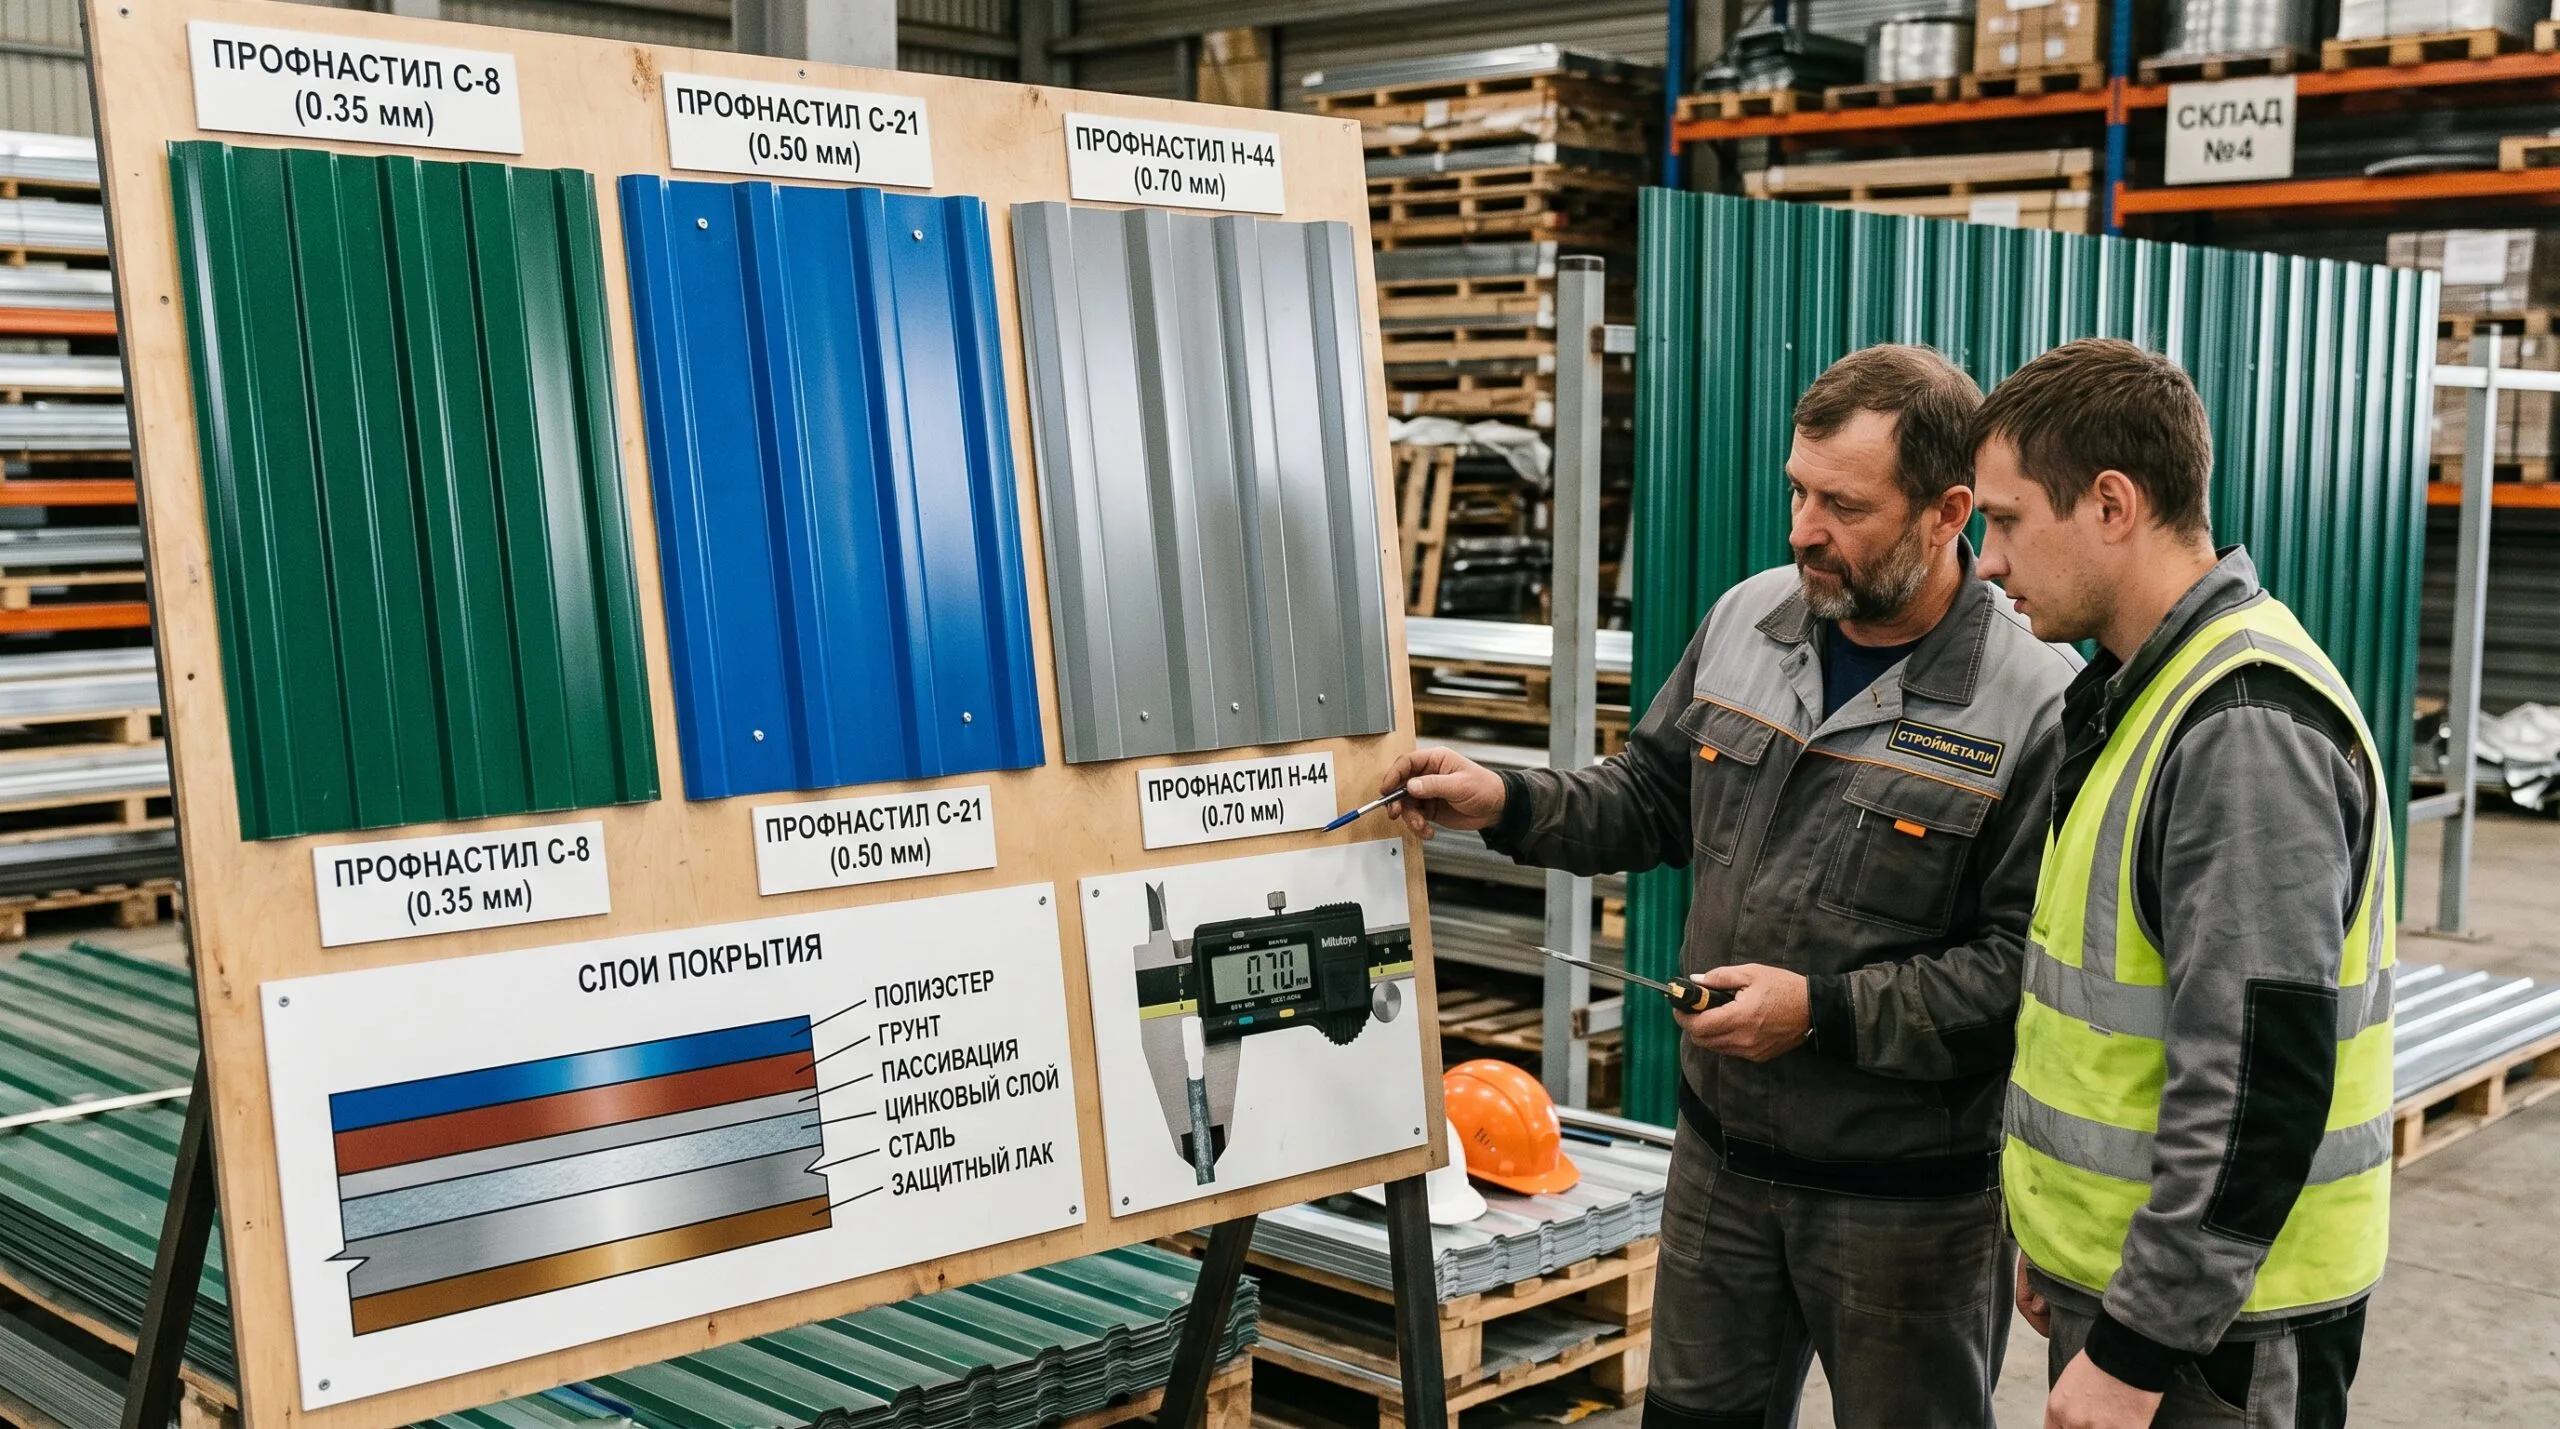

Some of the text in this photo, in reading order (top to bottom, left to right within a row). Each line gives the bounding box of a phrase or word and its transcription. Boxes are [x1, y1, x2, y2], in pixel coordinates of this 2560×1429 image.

[212, 38, 501, 95] ПРОФНАСТИЛ С-8
[295, 89, 434, 137] (0.35 мм)
[676, 87, 918, 136] ПРОФНАСТИЛ С-21
[2176, 97, 2284, 130] СКЛАД
[749, 132, 861, 174] (0.50 мм)
[1076, 126, 1275, 167] ПРОФНАСТИЛ Н-44
[2202, 137, 2255, 165] №4
[1134, 166, 1226, 202] (0.70 мм)
[1897, 729, 1995, 766] СТРОЙМЕТАЛИ
[1148, 762, 1328, 803] ПРОФНАСТИЛ Н-44
[766, 797, 981, 843] ПРОФНАСТИЛ С-21
[1202, 797, 1284, 834] (0.70 мм)
[334, 836, 590, 887] ПРОФНАСТИЛ С-8
[830, 836, 931, 877] (0.50 мм)
[407, 879, 532, 926] (0.35 мм)
[578, 933, 823, 993] СЛОИ ПОКРЫТИЯ
[1246, 948, 1295, 996] 0.70
[874, 969, 994, 1009] ПОЛИЭСТЕР
[878, 1014, 941, 1046] ГРУНТ
[881, 1038, 1019, 1084] ПАССИВАЦИЯ
[885, 1063, 1059, 1124] ЦИНКОВЫЙ СЛОЙ
[888, 1126, 956, 1158] СТАЛЬ
[891, 1141, 1054, 1196] ЗАЩИТНЫЙ ЛАК
